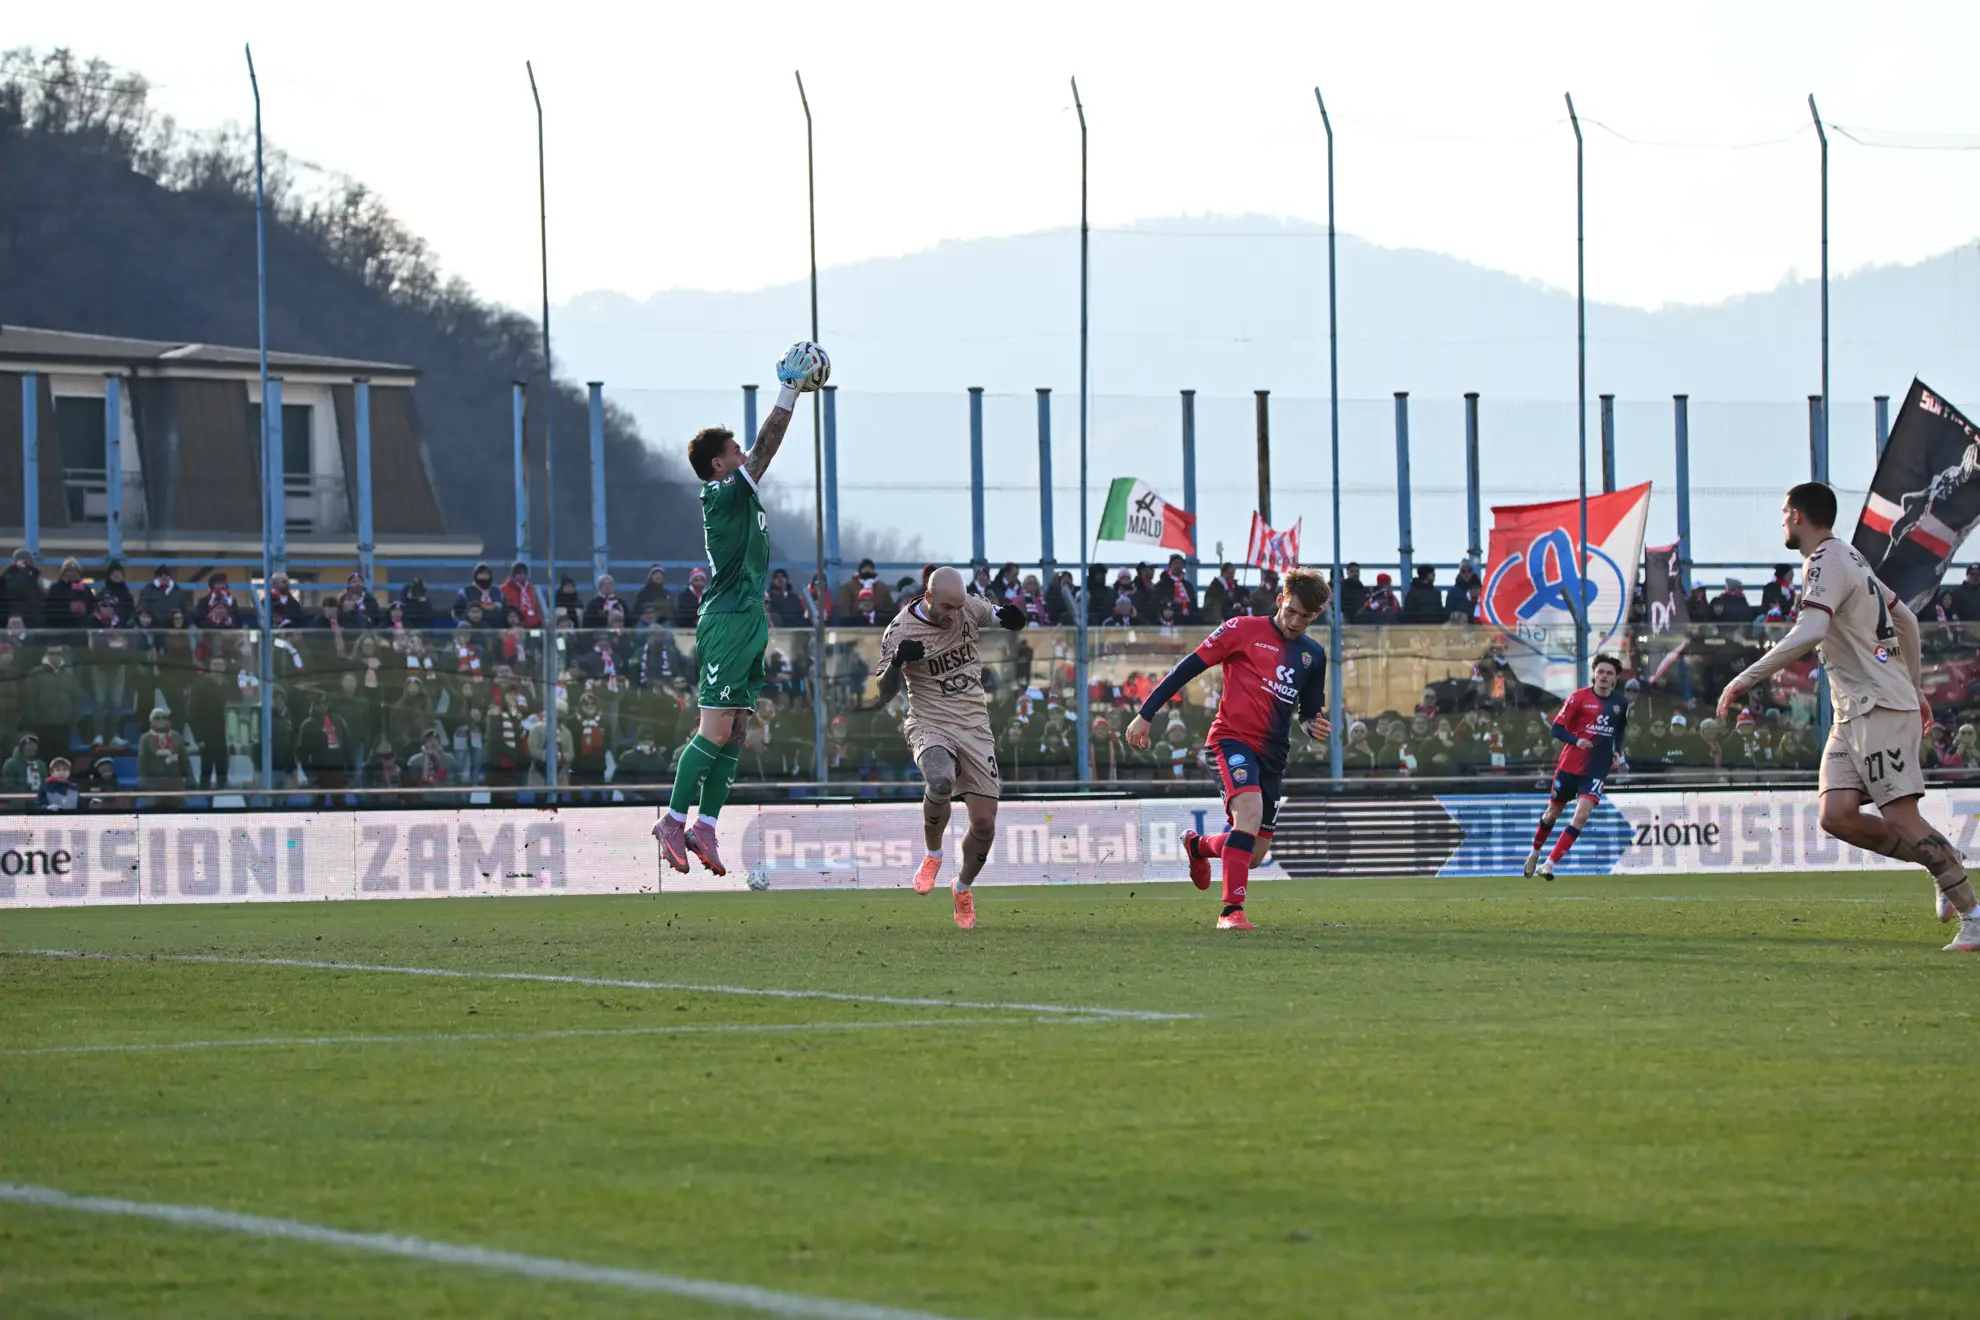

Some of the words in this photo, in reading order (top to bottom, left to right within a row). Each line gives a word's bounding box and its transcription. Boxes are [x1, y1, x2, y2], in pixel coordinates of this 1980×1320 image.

[928, 643, 975, 677] DIESEL
[1864, 751, 1885, 784] 27
[764, 829, 912, 869] Press
[1006, 821, 1140, 865] Metal
[1629, 815, 1720, 846] zione
[362, 822, 567, 892] ZAMA
